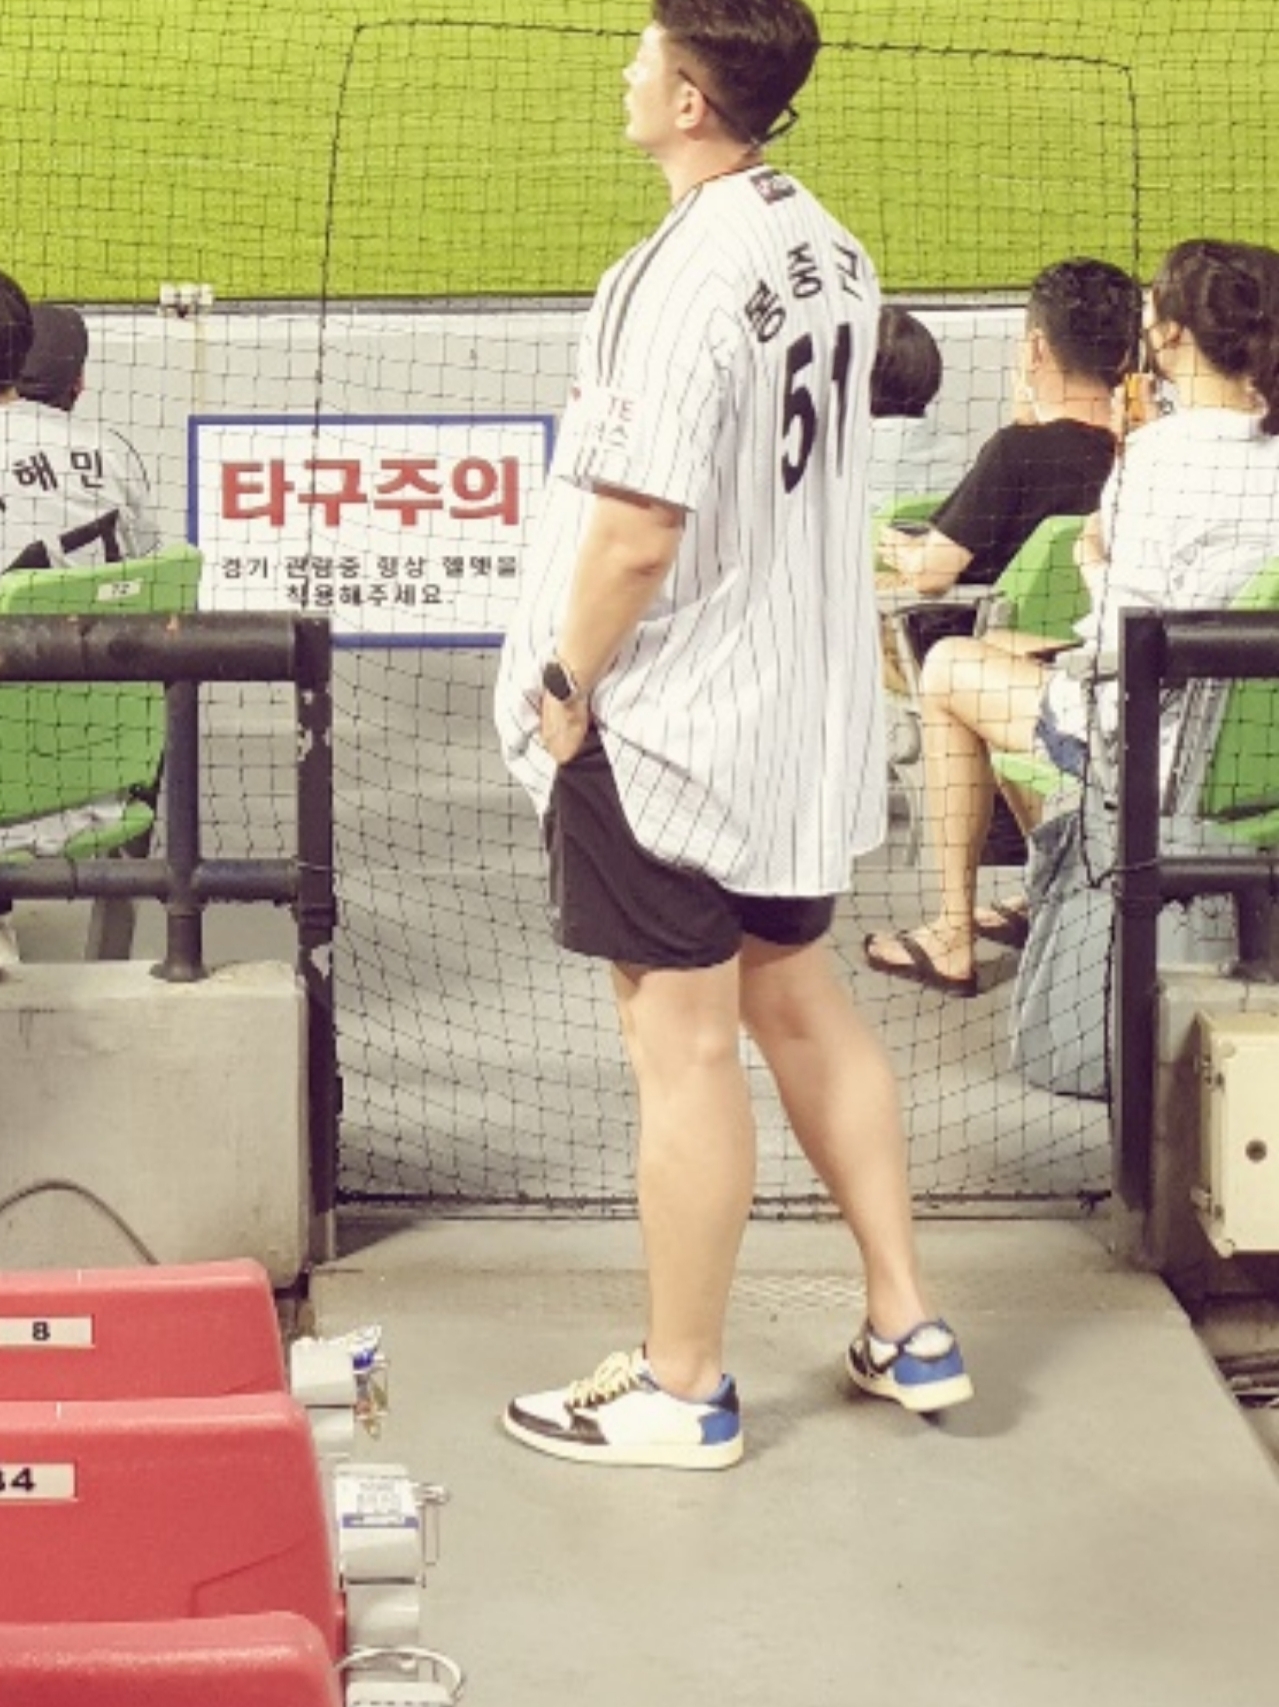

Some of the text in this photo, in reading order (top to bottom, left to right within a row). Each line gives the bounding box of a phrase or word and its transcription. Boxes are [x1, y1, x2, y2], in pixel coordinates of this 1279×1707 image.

[781, 320, 852, 494] 51
[221, 456, 519, 528] 타구주의
[222, 556, 269, 579] 경기
[377, 554, 426, 580] 항상
[31, 1321, 51, 1342] 8
